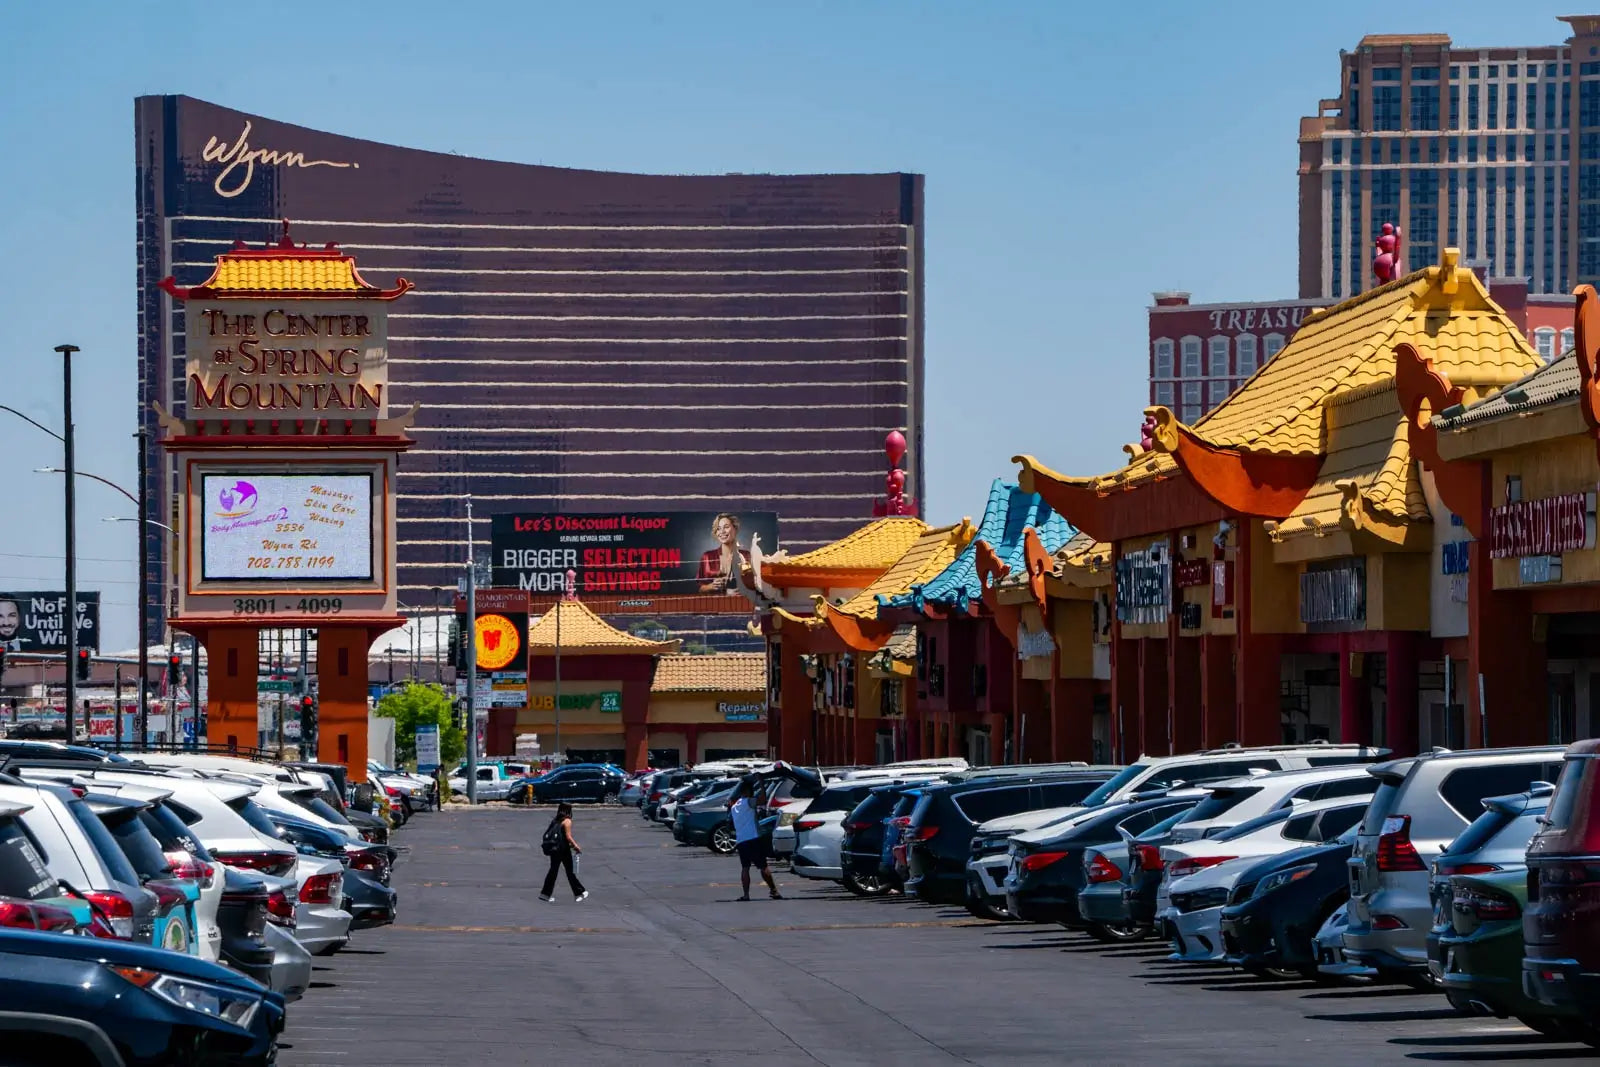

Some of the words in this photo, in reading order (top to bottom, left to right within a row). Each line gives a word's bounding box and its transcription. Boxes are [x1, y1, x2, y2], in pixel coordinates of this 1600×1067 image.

[202, 308, 257, 337] THE
[263, 308, 372, 337] CENTER
[214, 345, 232, 365] at
[238, 339, 361, 377] SPRING
[190, 373, 383, 411] MOUNTAIN
[310, 485, 355, 501] Massage
[309, 512, 345, 529] Waxing
[514, 516, 552, 531] Lee's
[555, 516, 619, 531] Discount
[621, 515, 670, 532] Liquor
[247, 556, 335, 569] 702.788.1199
[503, 549, 577, 569] BIGGER
[583, 548, 681, 569] SELECTION
[583, 571, 661, 592] SAVINGS
[31, 597, 54, 613] No
[57, 597, 87, 613] Fe
[234, 598, 277, 615] 3801
[296, 598, 343, 615] 4099
[25, 614, 64, 629] Until
[719, 701, 760, 714] Repairs
